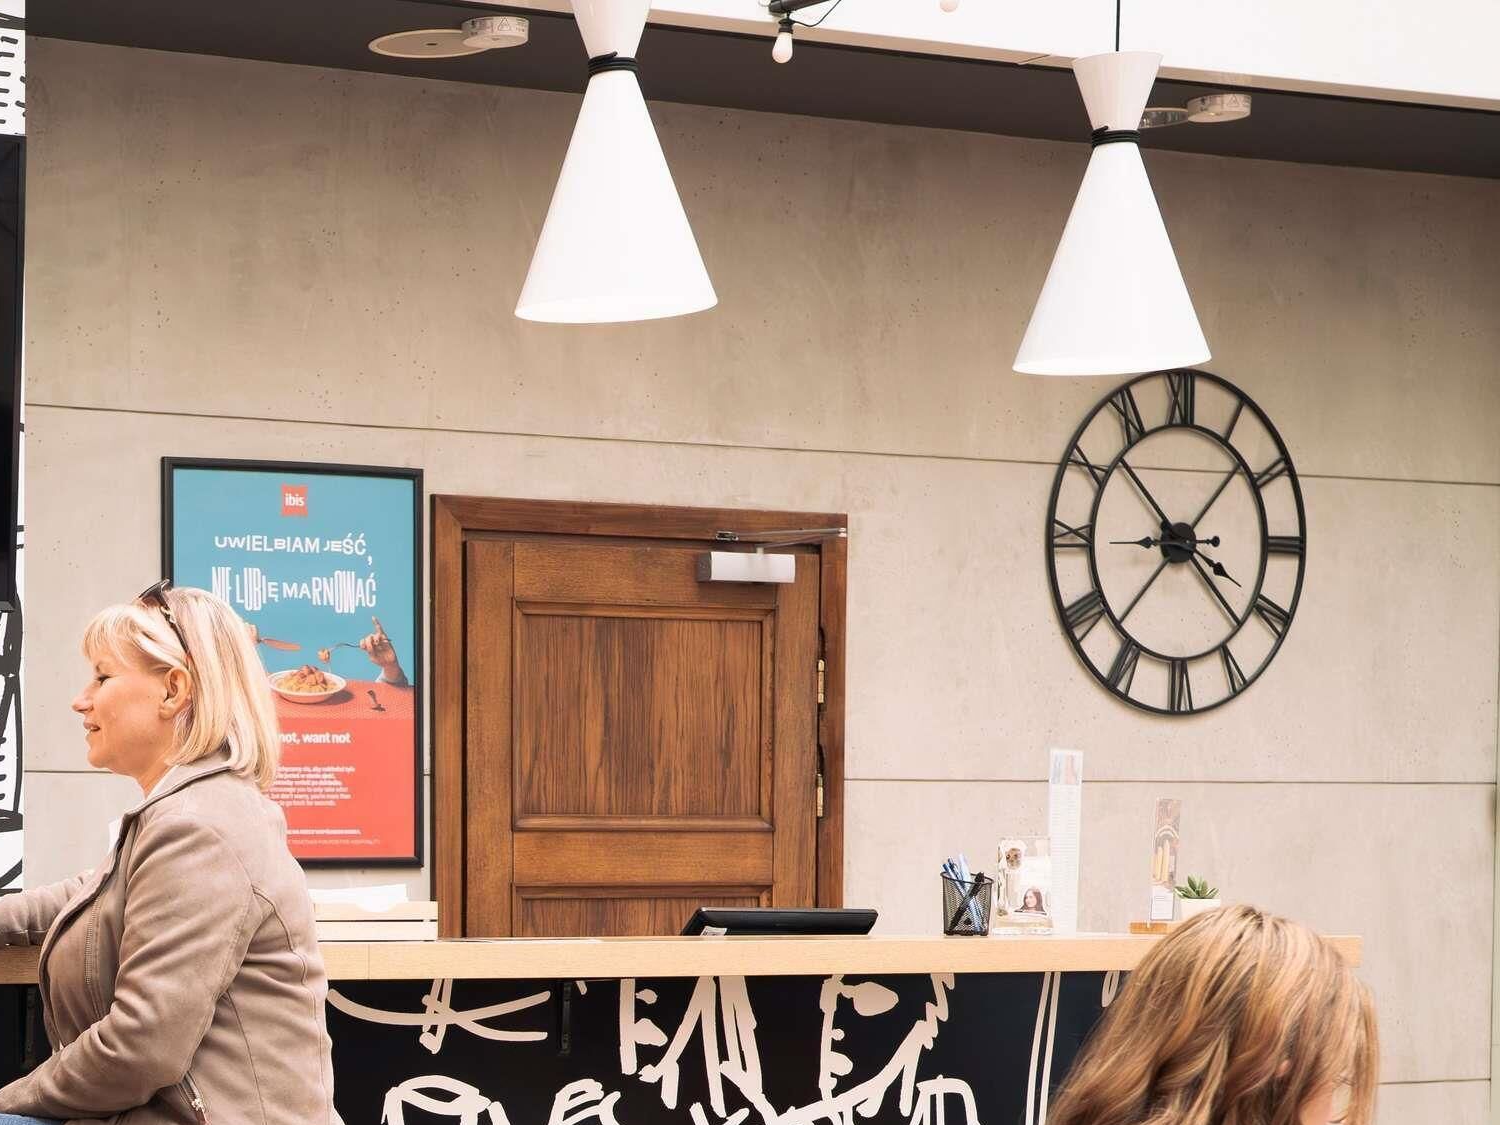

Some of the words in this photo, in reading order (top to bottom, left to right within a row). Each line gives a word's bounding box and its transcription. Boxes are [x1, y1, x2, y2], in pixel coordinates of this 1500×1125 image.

[1167, 373, 1195, 425] XII
[285, 493, 305, 507] ibis
[215, 535, 320, 553] UWIELBIAM
[323, 533, 373, 565] JEŚĆ,
[235, 568, 279, 611] LUBIĘ
[282, 571, 377, 613] MARNOWAĆ
[302, 732, 331, 743] want
[332, 732, 351, 743] not
